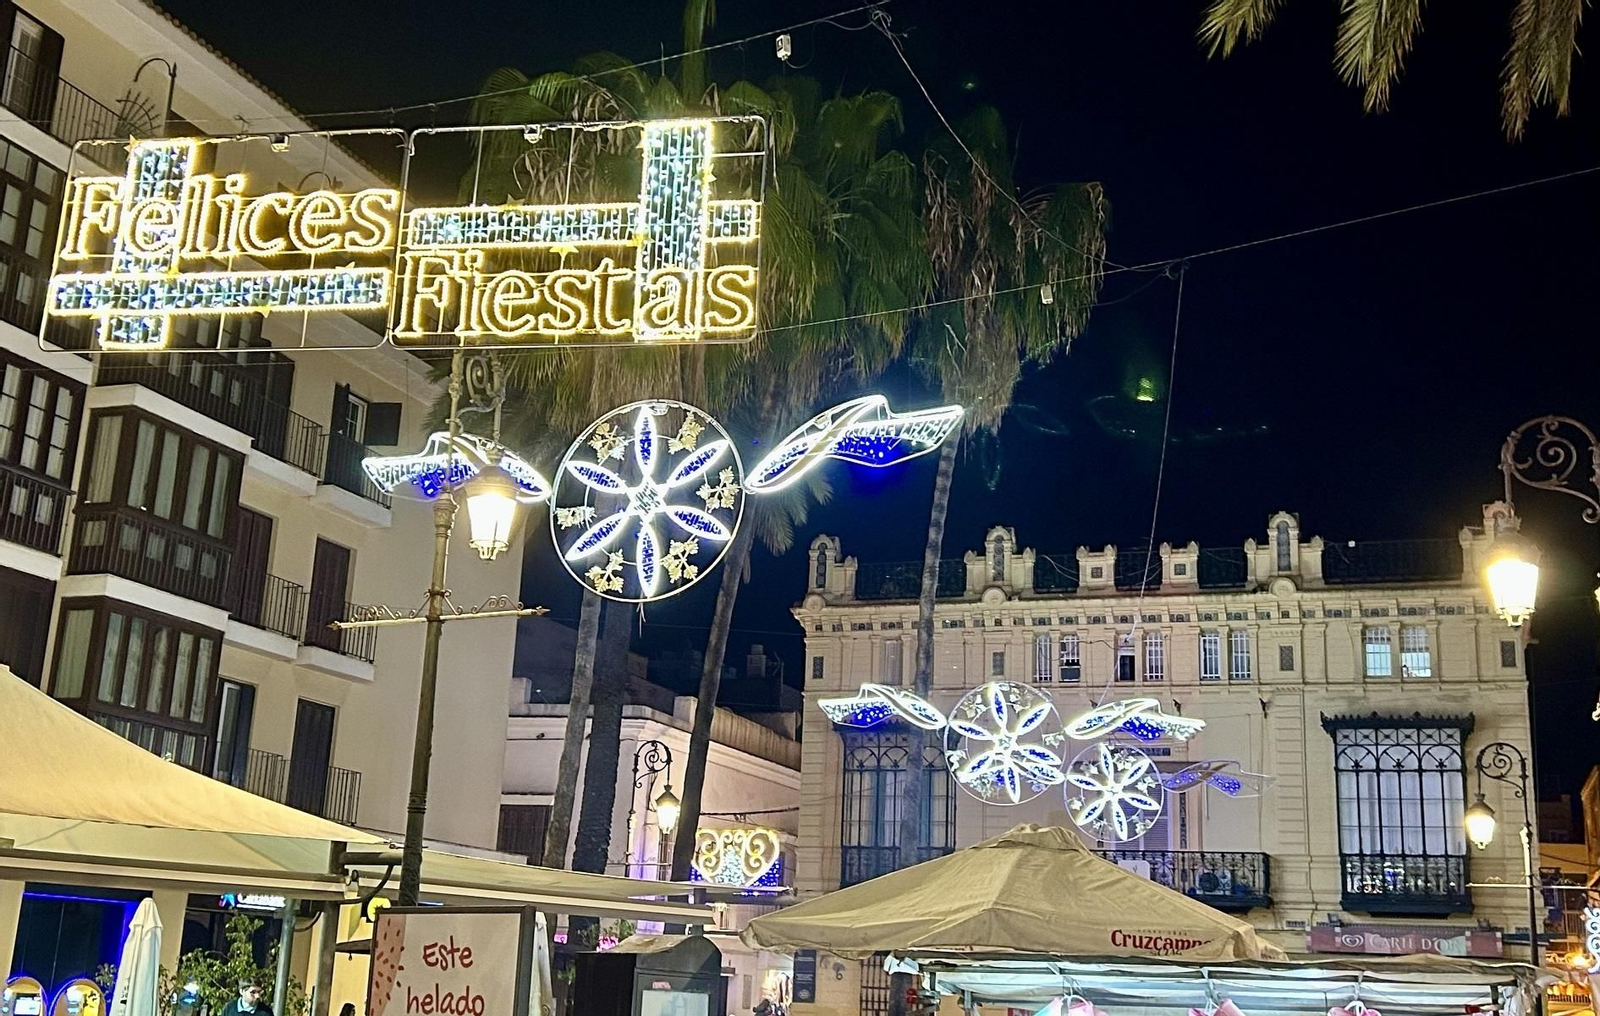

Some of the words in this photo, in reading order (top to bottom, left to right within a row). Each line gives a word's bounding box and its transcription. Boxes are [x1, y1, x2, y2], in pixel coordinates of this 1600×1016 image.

[60, 174, 400, 260] Felices
[394, 250, 758, 339] Fiestas
[423, 935, 473, 971] Este
[407, 983, 485, 1016] helado
